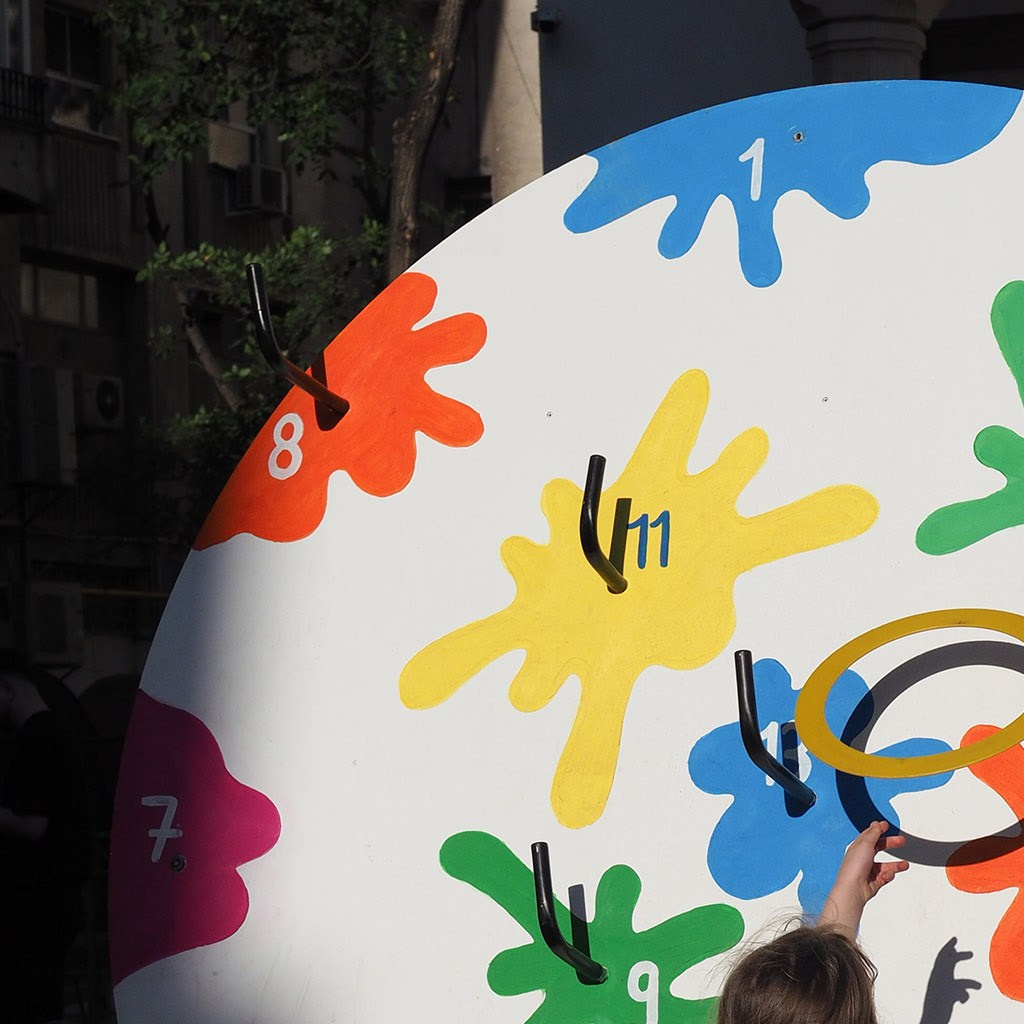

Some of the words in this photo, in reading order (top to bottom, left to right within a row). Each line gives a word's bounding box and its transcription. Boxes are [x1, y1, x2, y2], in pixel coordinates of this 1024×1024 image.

[738, 137, 765, 202] 1
[267, 412, 304, 481] 8
[626, 510, 669, 570] 11
[141, 795, 184, 863] 7
